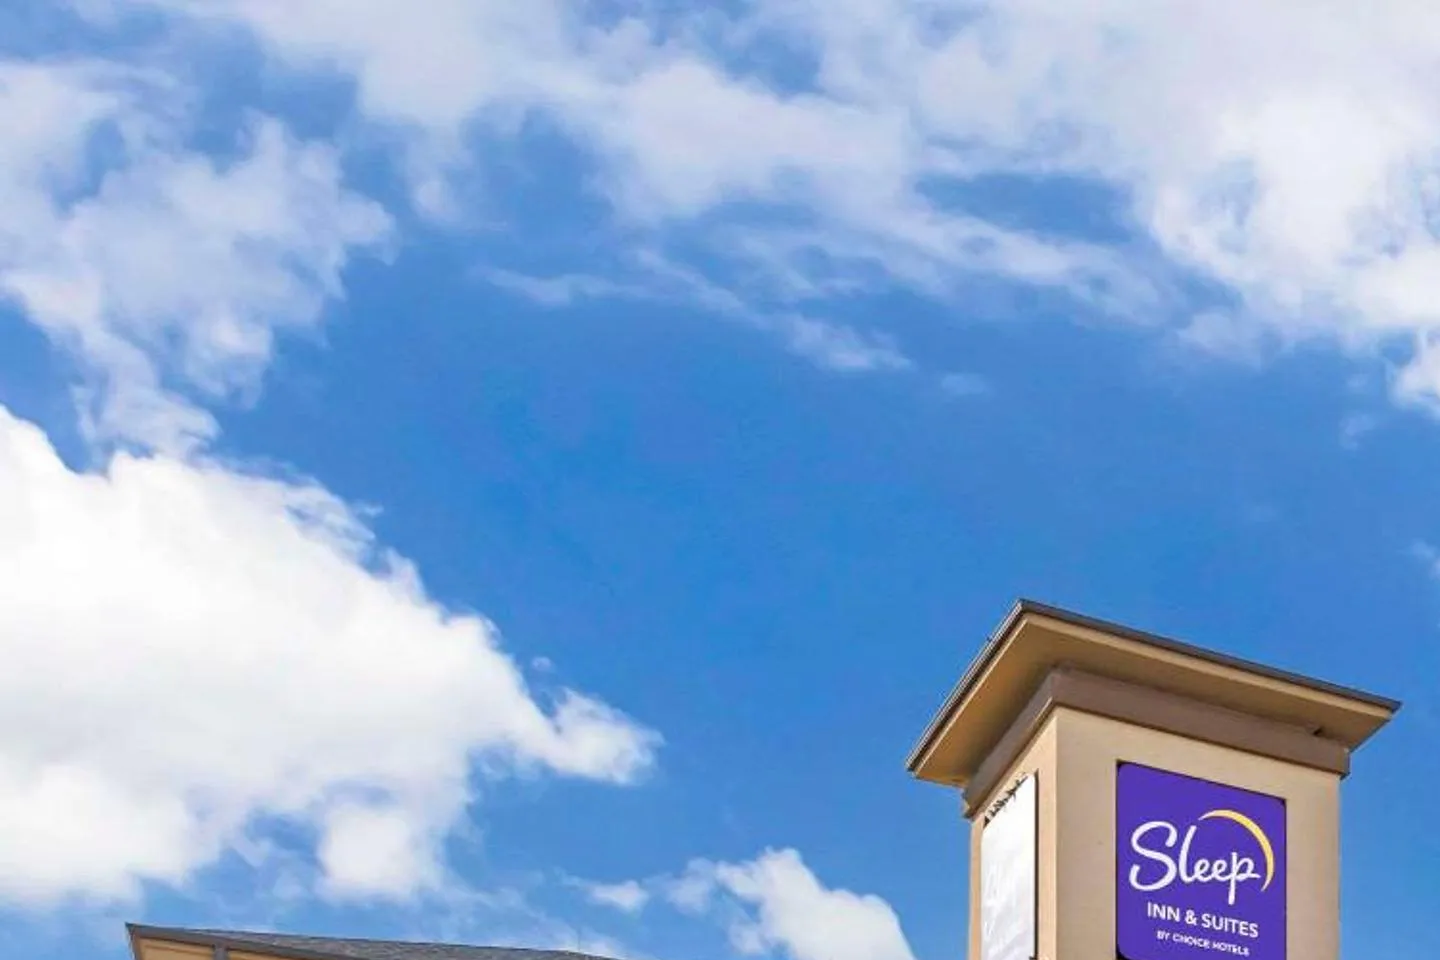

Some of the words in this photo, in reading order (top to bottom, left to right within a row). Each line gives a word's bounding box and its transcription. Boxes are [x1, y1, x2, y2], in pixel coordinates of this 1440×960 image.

[1129, 821, 1261, 905] Sleep
[1147, 901, 1180, 922] INN
[1185, 909, 1197, 926] &
[1201, 913, 1259, 938] SUITES
[1156, 930, 1170, 941] BY
[1172, 933, 1210, 949] CHOICE
[1212, 941, 1250, 957] HOTELS
